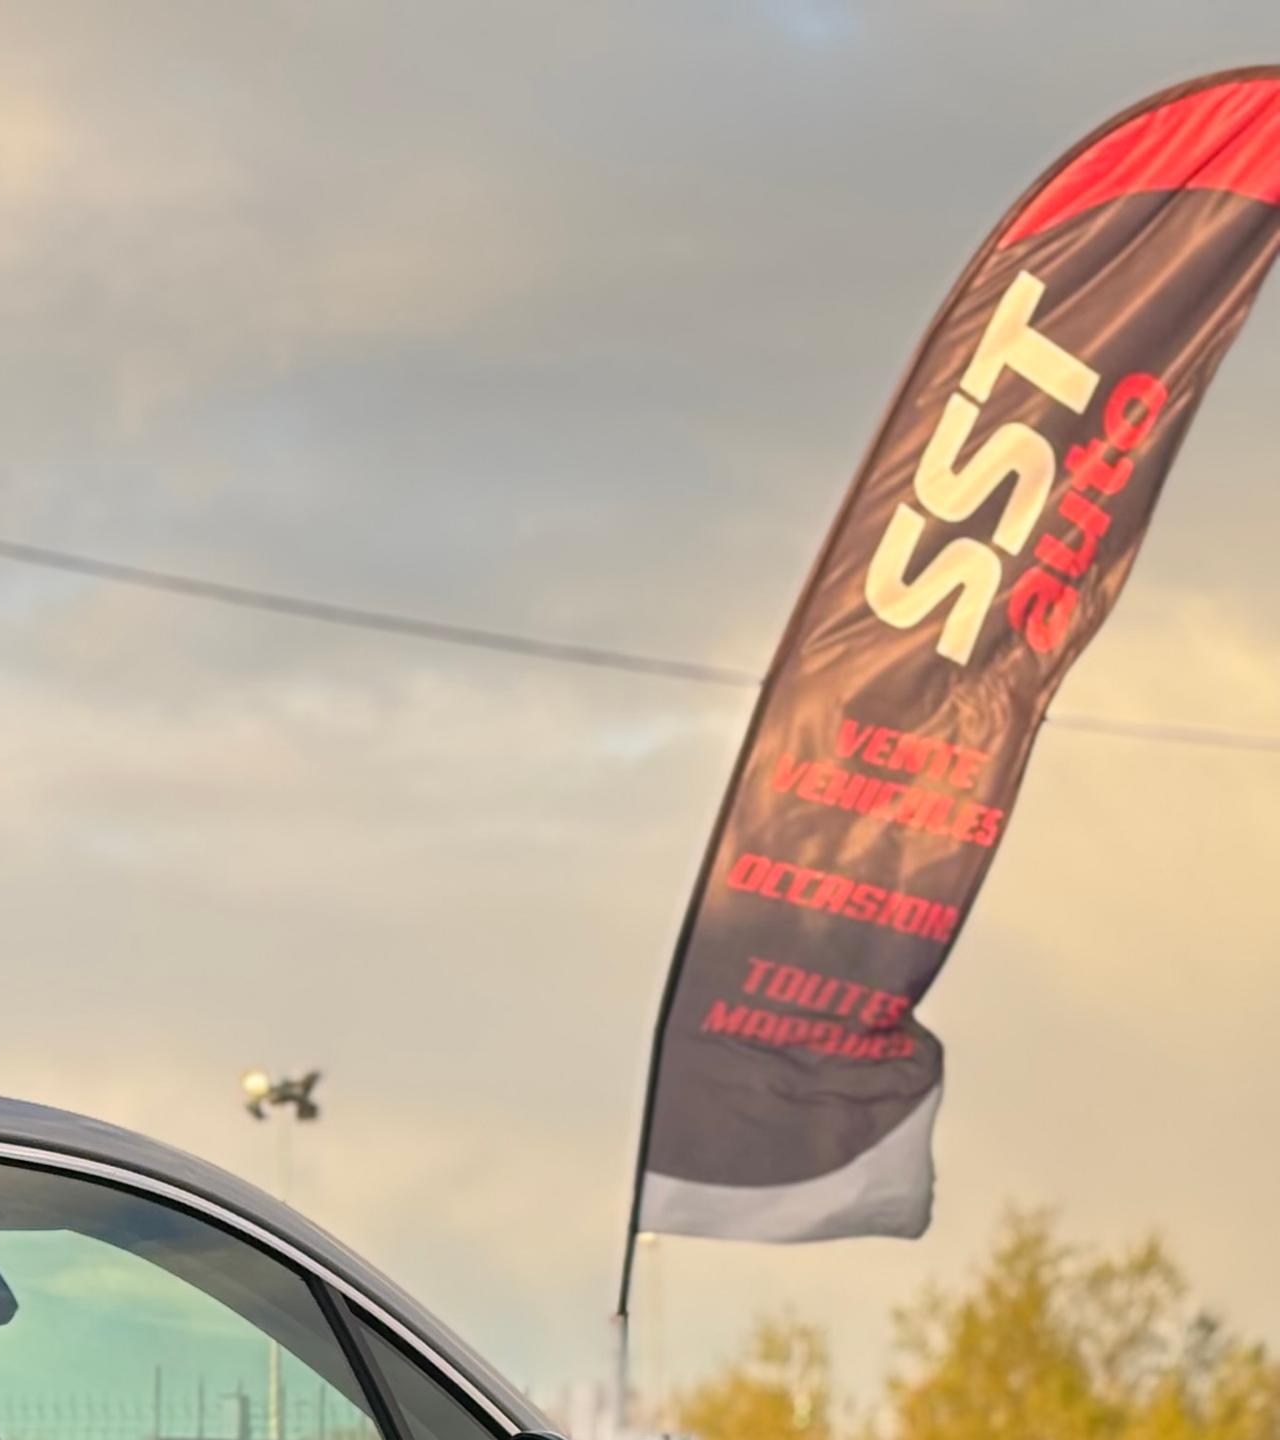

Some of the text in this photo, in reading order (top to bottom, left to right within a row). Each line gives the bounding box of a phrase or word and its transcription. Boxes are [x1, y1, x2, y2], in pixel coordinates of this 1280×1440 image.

[864, 269, 1101, 667] SST
[1007, 371, 1168, 653] auto
[837, 718, 991, 789] VENTE
[742, 957, 910, 1029] TOUTES
